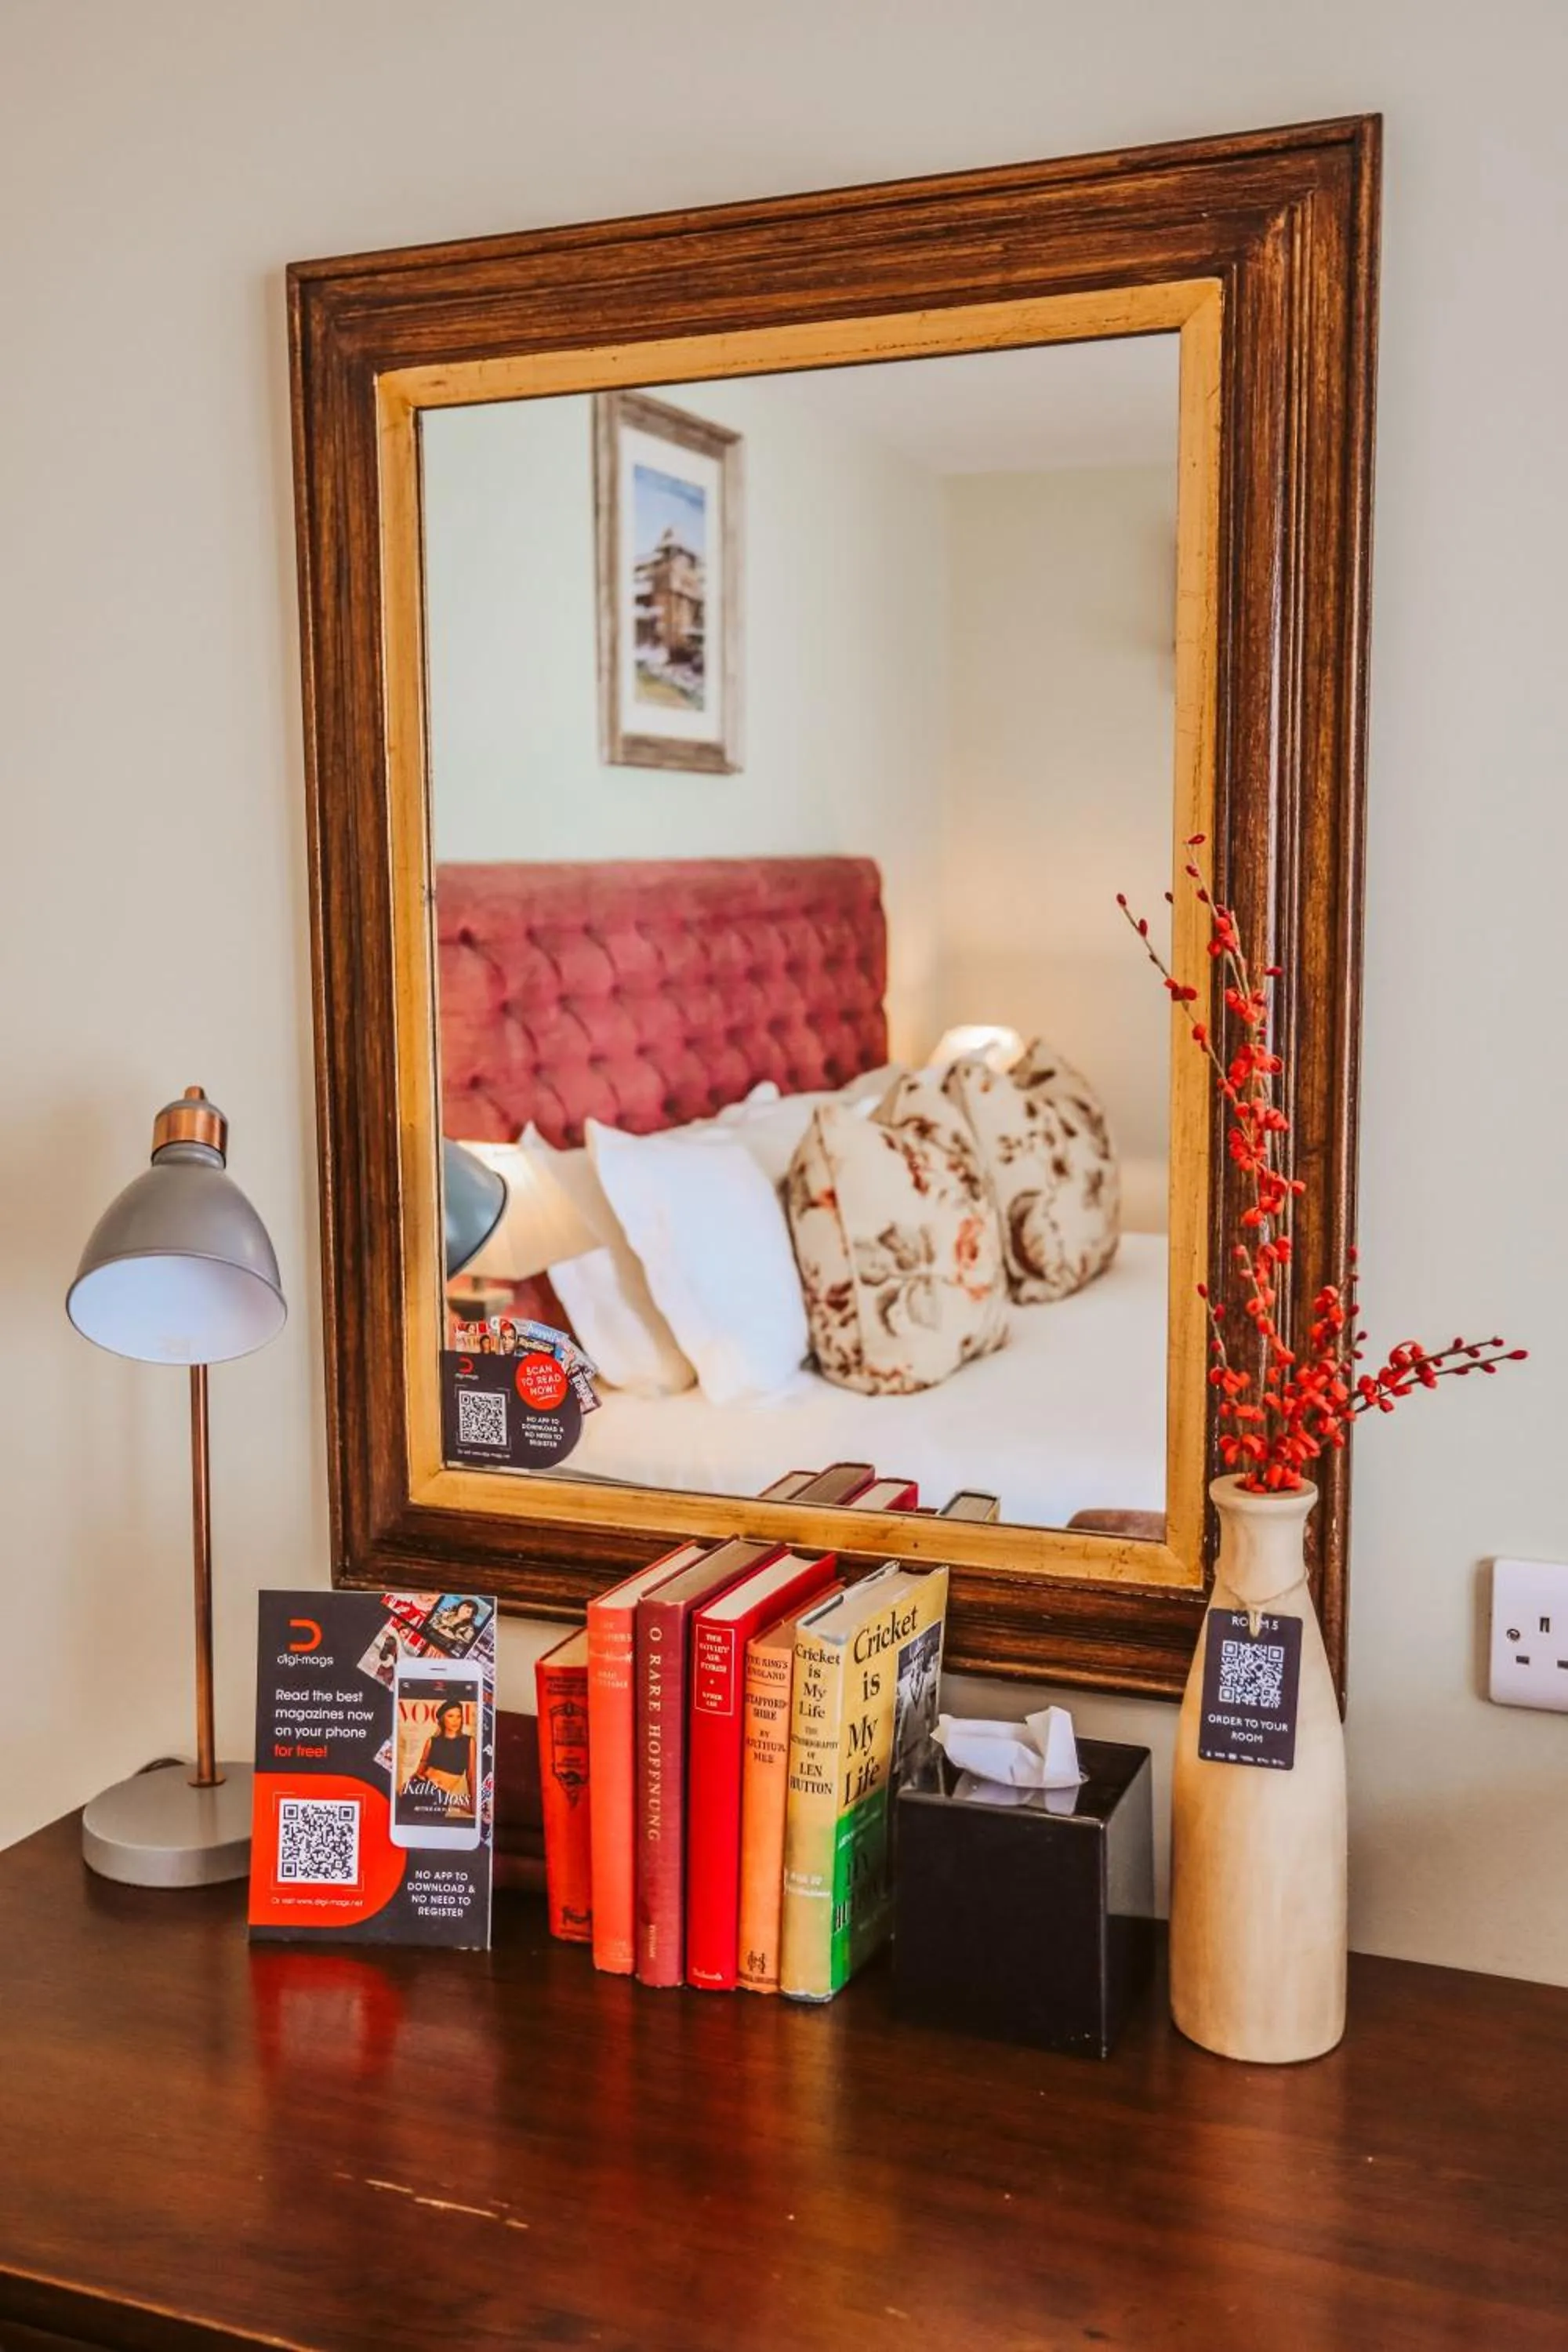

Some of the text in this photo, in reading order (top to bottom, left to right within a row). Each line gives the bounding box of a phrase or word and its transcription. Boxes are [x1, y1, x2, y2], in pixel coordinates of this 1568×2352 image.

[526, 1364, 553, 1376] SCAN
[521, 1375, 561, 1386] TO READ
[1232, 1615, 1279, 1632] ROM 5
[854, 1605, 919, 1664] Cricket
[277, 1653, 334, 1668] digi-mags
[795, 1643, 840, 1665] Cricket
[808, 1664, 821, 1679] is
[648, 1653, 661, 1711] RARE
[863, 1671, 880, 1701] is
[275, 1689, 364, 1703] Read the best
[803, 1682, 827, 1701] My
[275, 1708, 375, 1722] magazines now
[799, 1701, 826, 1719] Life
[1207, 1713, 1289, 1732] ORDER TO YOUR
[275, 1726, 367, 1740] on your phone
[847, 1715, 878, 1758] My
[1231, 1731, 1264, 1744] ROOM
[274, 1743, 328, 1758] for free!
[799, 1762, 822, 1777] LEN
[402, 1779, 437, 1795] Kate
[648, 1724, 661, 1841] HOFFNUNG
[790, 1775, 833, 1795] HUTTON
[844, 1756, 880, 1807] Life
[415, 1870, 468, 1882] NO APP TO
[407, 1882, 465, 1893] DOWNLOAD
[412, 1895, 471, 1906] NO NEED TO
[418, 1907, 463, 1918] REGISTER
